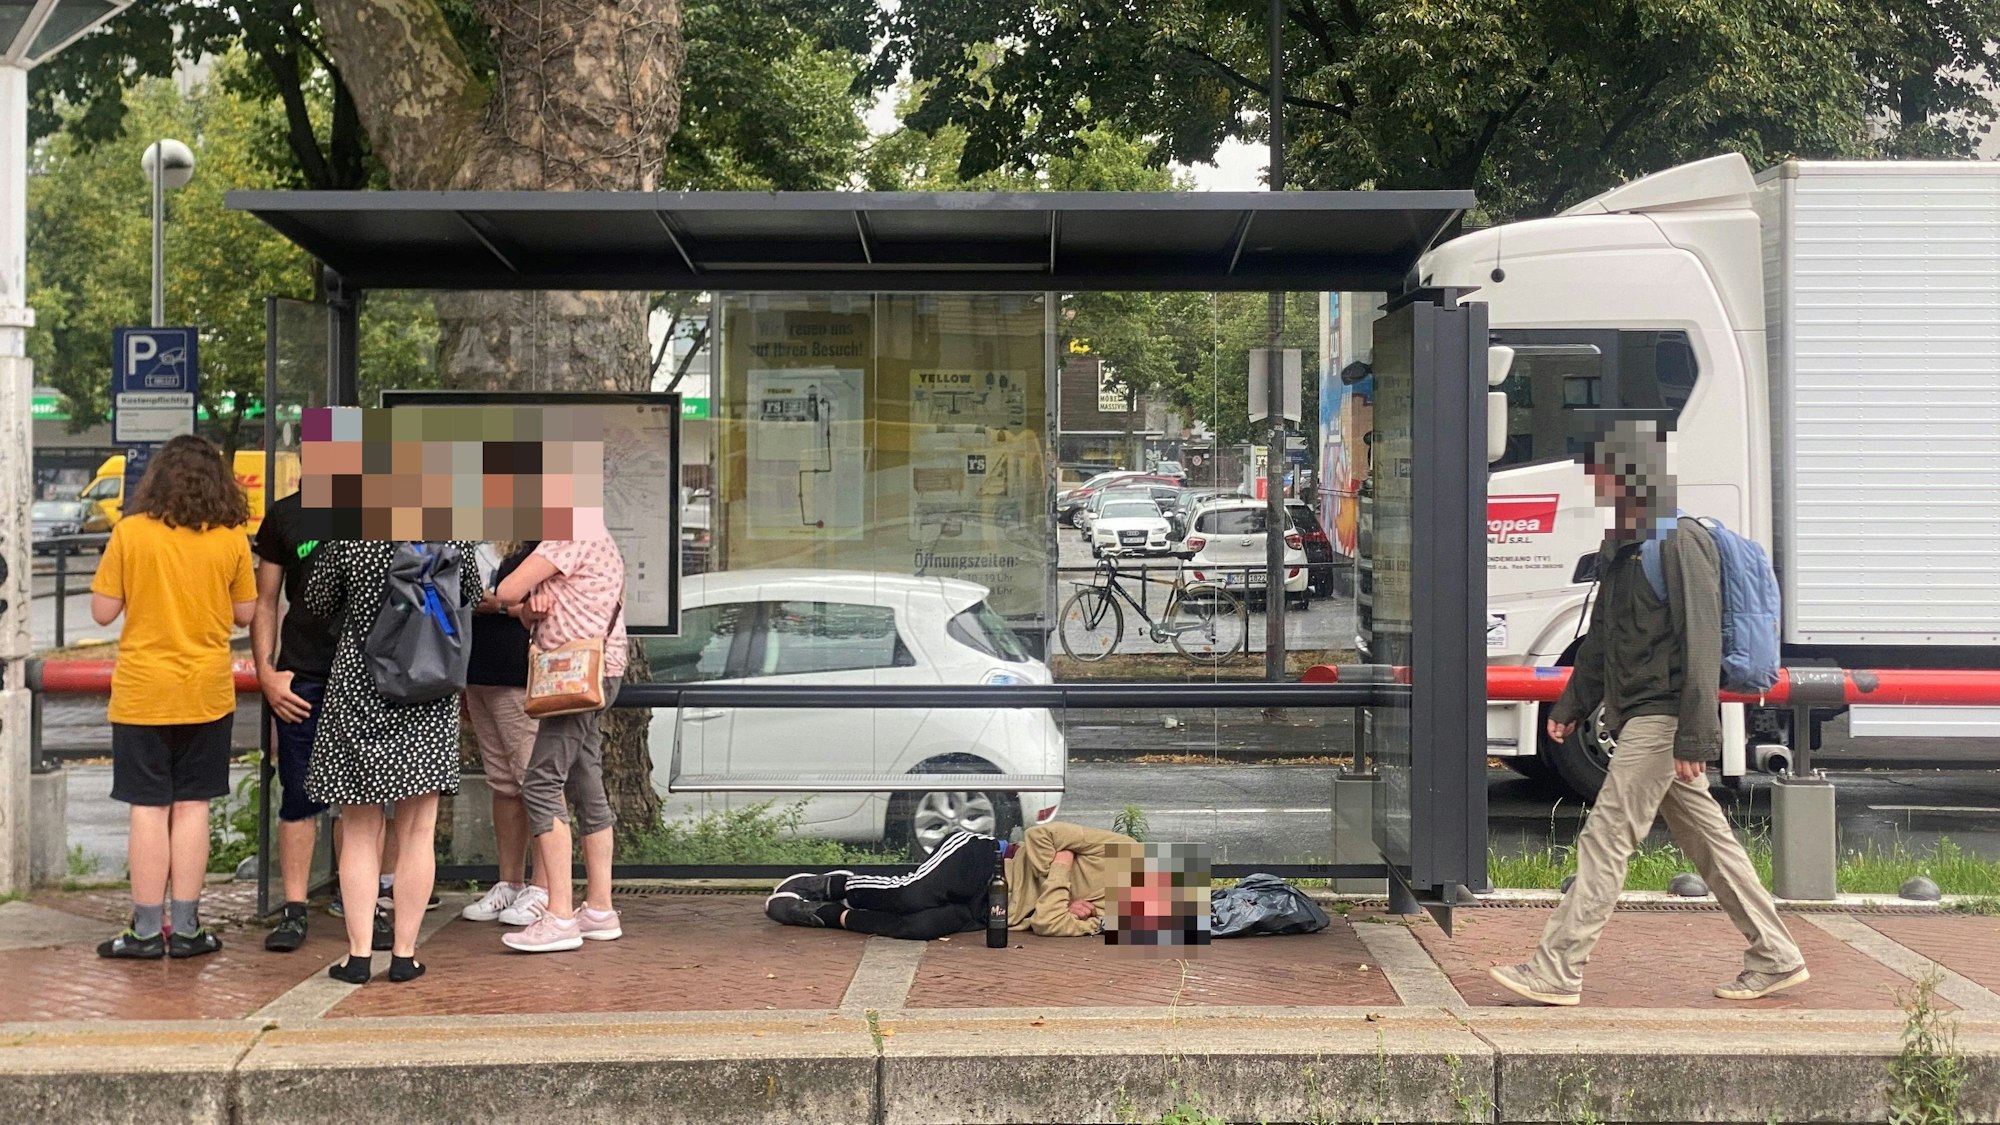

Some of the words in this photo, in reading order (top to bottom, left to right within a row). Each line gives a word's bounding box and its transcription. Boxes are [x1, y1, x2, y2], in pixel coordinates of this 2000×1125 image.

[831, 323, 853, 335] uns
[128, 335, 157, 375] P
[774, 342, 807, 358] Ihren
[812, 341, 862, 357] Besuch!
[919, 373, 971, 384] YELLOW
[121, 396, 190, 405] Kostenpflichtig
[766, 401, 782, 414] rs
[127, 448, 138, 463] P
[968, 458, 985, 471] rs
[1487, 518, 1541, 543] ropea
[1508, 536, 1533, 544] S.R.L.
[914, 548, 1019, 569] Öffnungszeiten:
